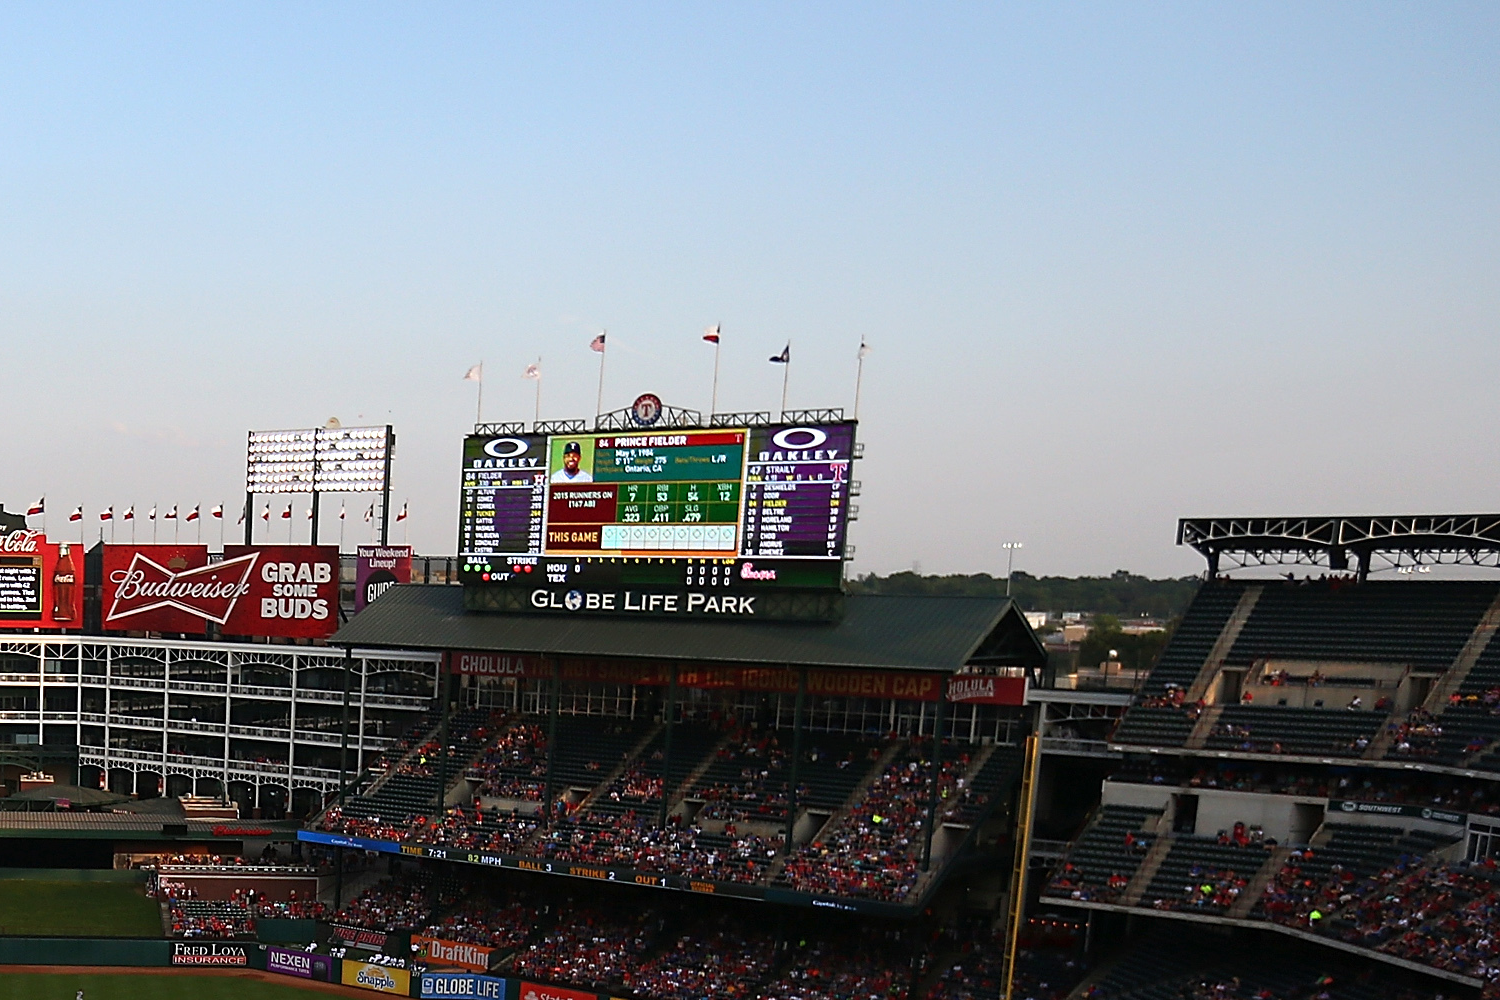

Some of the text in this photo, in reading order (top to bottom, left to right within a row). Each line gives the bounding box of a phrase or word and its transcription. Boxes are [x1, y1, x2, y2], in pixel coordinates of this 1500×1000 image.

[615, 436, 687, 447] PRINCE FIELDER
[759, 450, 839, 461] OAKLEY
[473, 458, 538, 468] OAKLEY
[750, 466, 796, 475] 47 STRAILY
[602, 491, 612, 499] ON
[630, 493, 636, 502] 7
[656, 493, 668, 501] 53
[719, 492, 730, 501] 12
[622, 513, 701, 522] .323 .411 .479
[549, 531, 599, 543] THIS GAME
[359, 547, 409, 558] Your Weekend
[369, 559, 396, 570] Lineup!
[506, 557, 538, 565] STRIKE
[261, 562, 332, 583] GRAB
[547, 564, 581, 573] HOU 0
[109, 570, 250, 599] Budweiser
[547, 574, 566, 583] TEX
[273, 584, 318, 597] SOME
[260, 598, 329, 620] BUDS
[624, 592, 678, 612] LIFE
[687, 593, 757, 614] PARK
[460, 655, 525, 674] CHOLULA
[806, 671, 886, 695] WOODEN
[892, 676, 932, 697] CAP
[1358, 804, 1402, 813] SOUTHWEST
[401, 845, 502, 866] TIME 7:21 82 MPH
[518, 860, 666, 887] BALL 3 STRIKE 2 OUT 1
[333, 927, 355, 941] TIRE
[354, 932, 388, 947] PROS
[174, 943, 246, 956] FRED LOYA
[174, 955, 245, 964] INSURANCE
[270, 951, 310, 969] NEXEN
[356, 971, 396, 990] Snapple
[435, 978, 500, 999] GLOBE LIFE
